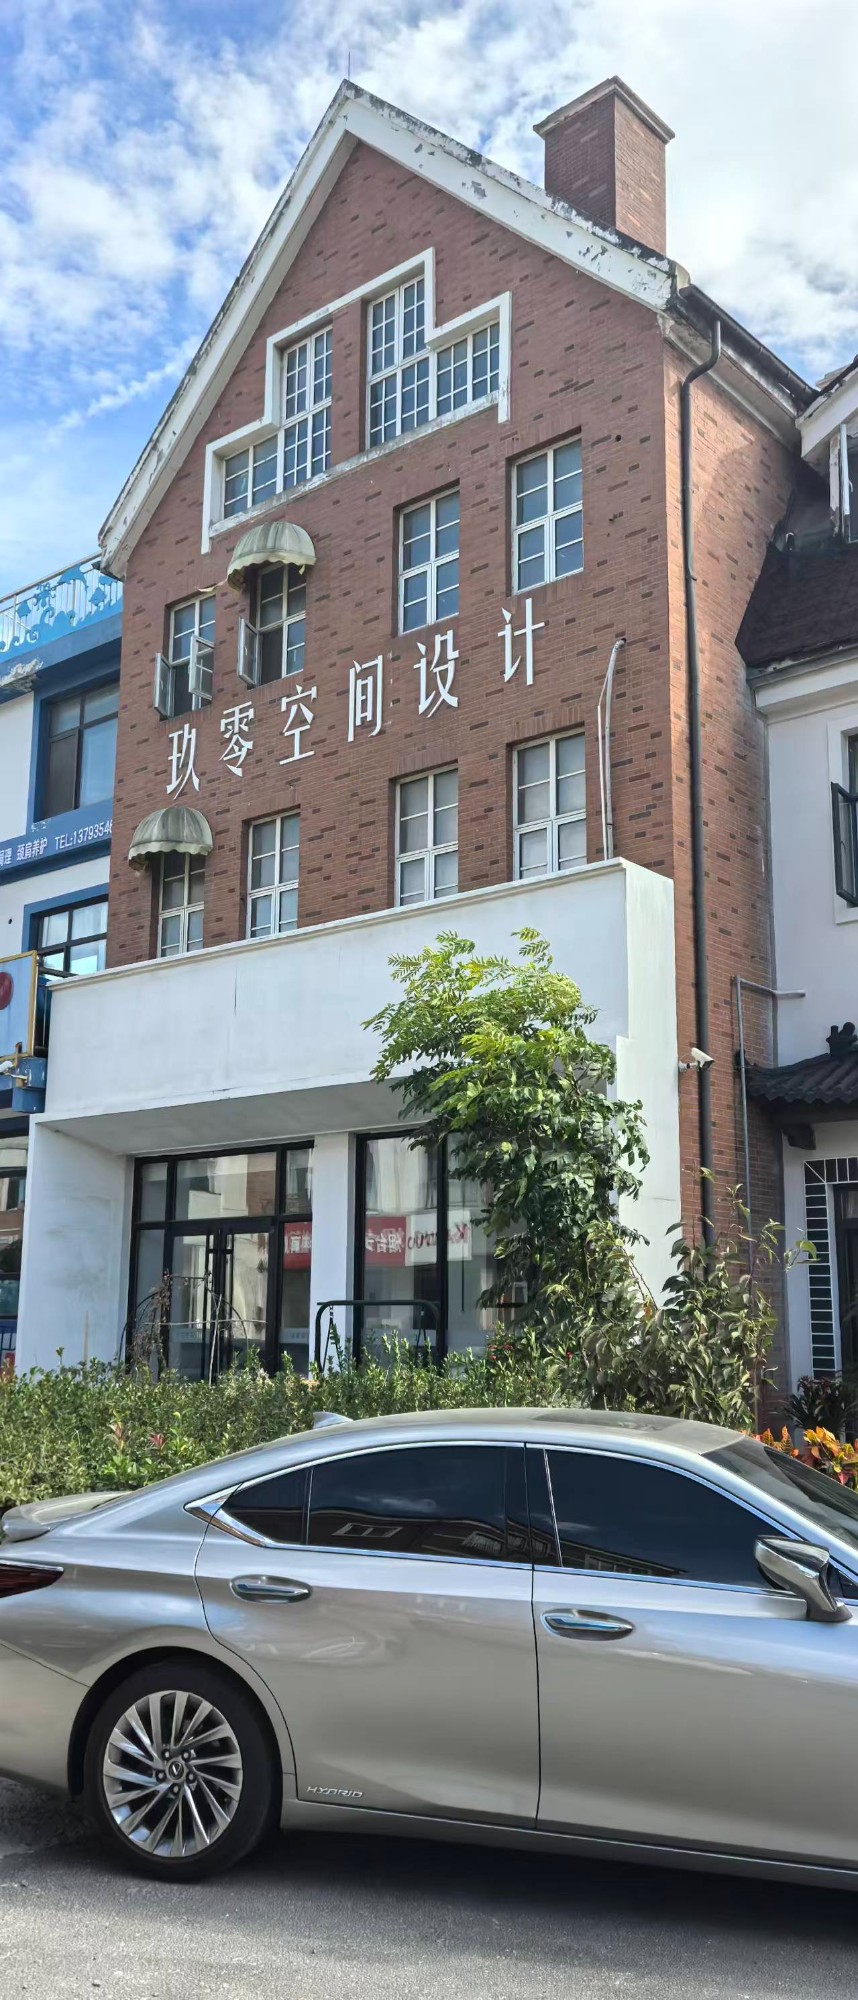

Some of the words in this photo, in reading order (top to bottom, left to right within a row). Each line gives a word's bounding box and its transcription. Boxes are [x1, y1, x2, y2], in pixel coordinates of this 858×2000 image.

[166, 598, 545, 800] 玖零空间设计
[16, 837, 48, 861] 颈肩养护
[307, 1786, 363, 1798] HYBRID
